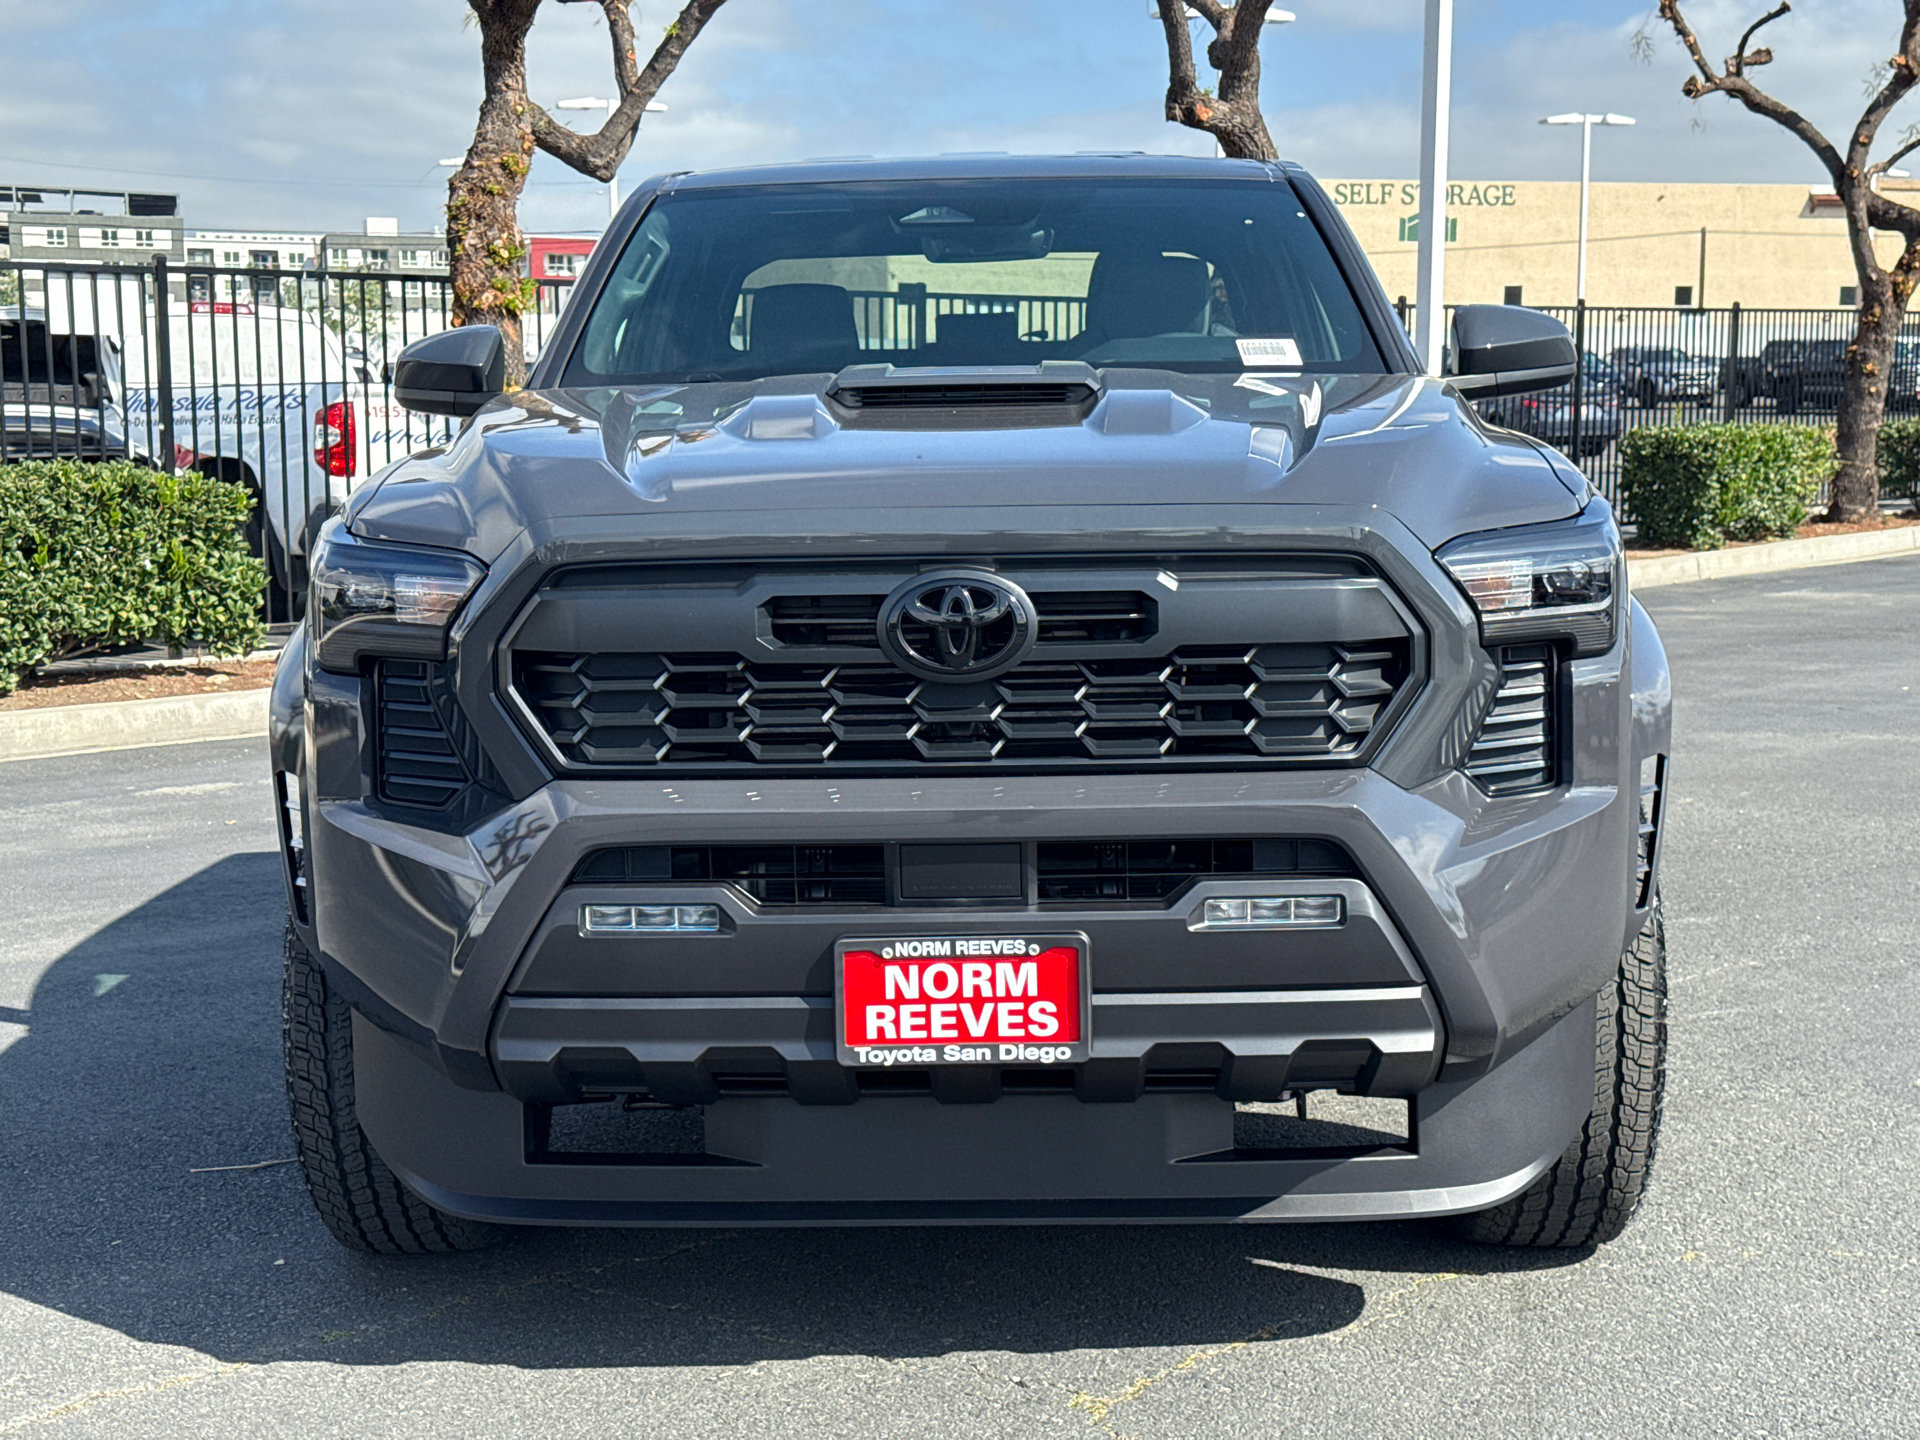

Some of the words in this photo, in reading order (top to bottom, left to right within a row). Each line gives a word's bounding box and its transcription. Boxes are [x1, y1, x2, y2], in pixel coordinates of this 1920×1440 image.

[1334, 184, 1395, 205] SELF
[1401, 184, 1516, 206] SRAGE
[227, 387, 309, 410] Parts
[895, 941, 951, 957] NORM
[956, 940, 1026, 956] REEVES
[884, 962, 1039, 1000] NORM
[865, 1001, 1060, 1040] REEVES
[854, 1046, 937, 1066] Toyota
[943, 1044, 991, 1062] San
[998, 1043, 1072, 1064] Diego
